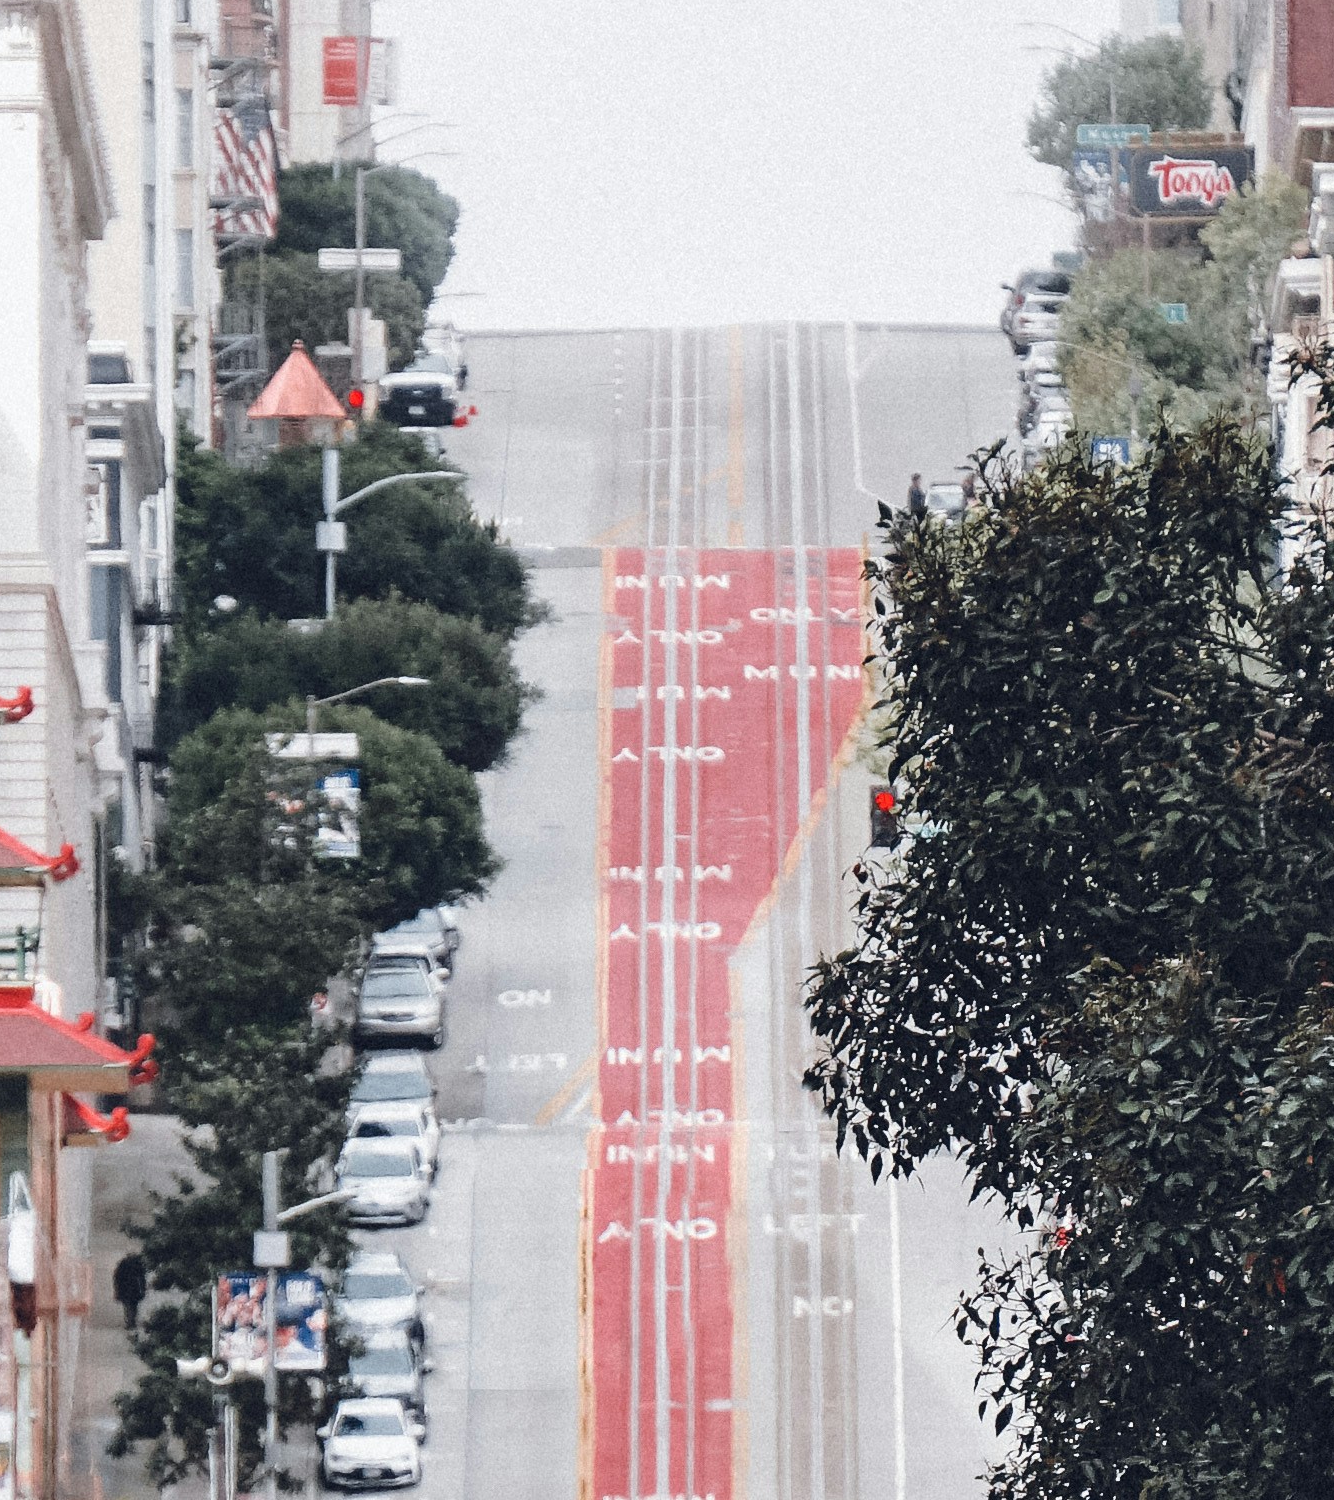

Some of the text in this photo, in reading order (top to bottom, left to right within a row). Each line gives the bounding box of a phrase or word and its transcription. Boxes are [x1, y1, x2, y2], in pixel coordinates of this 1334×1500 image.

[1151, 156, 1234, 205] Tonga
[615, 573, 731, 590] MUNI
[612, 746, 725, 763] ONLY
[611, 923, 722, 941] ONLY
[607, 1046, 732, 1066] MUNI
